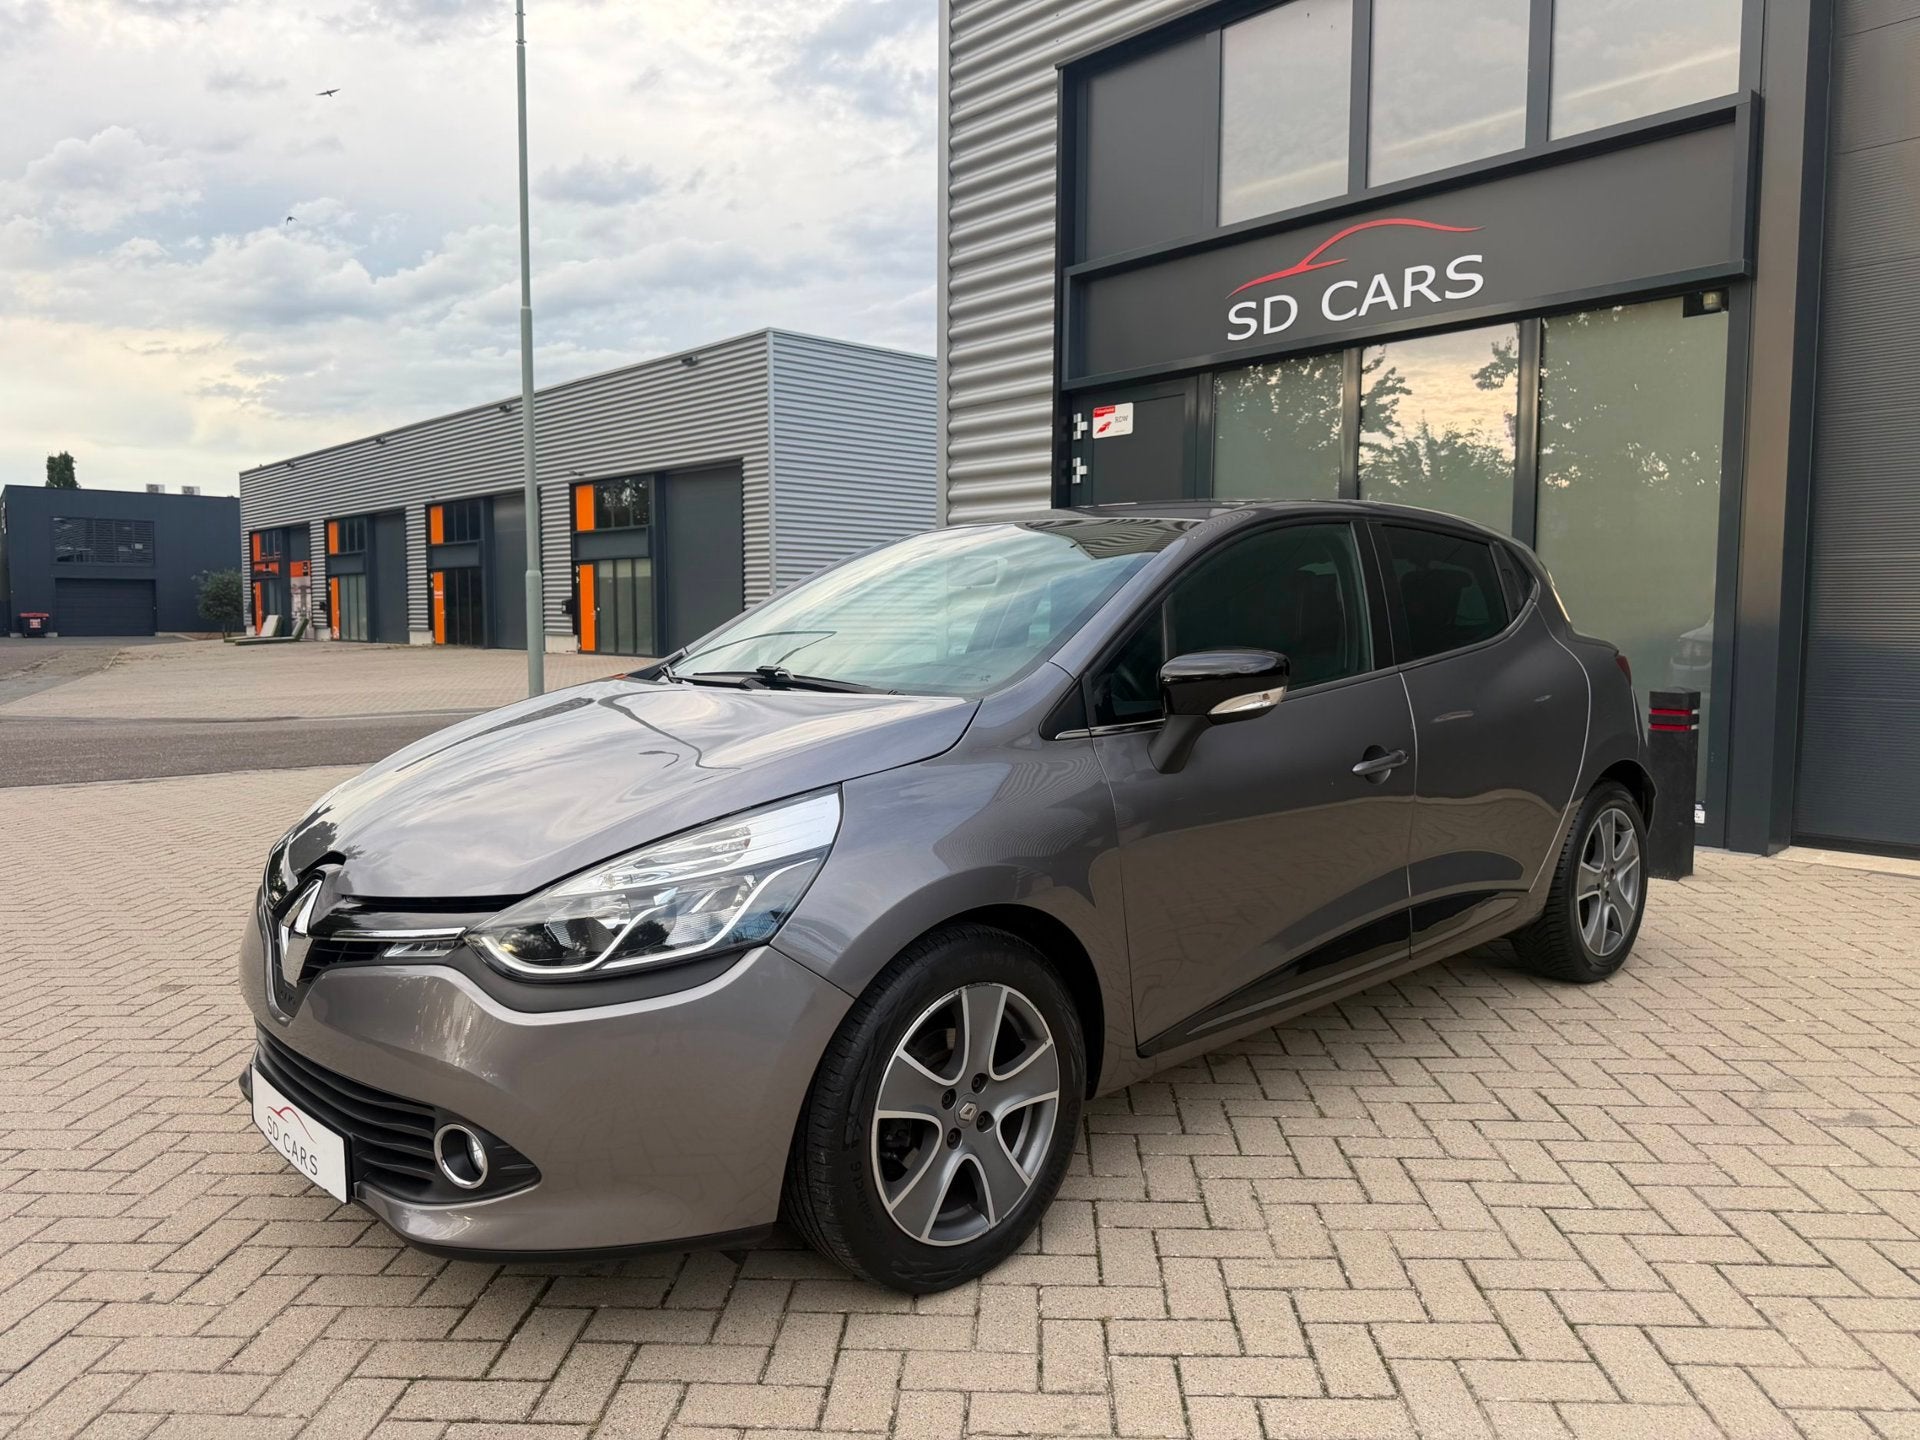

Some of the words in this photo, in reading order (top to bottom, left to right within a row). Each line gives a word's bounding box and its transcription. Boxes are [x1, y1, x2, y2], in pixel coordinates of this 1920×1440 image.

[1227, 294, 1298, 341] SD
[1321, 254, 1484, 322] CARS
[267, 1115, 279, 1141] SD
[283, 1132, 318, 1176] CARS
